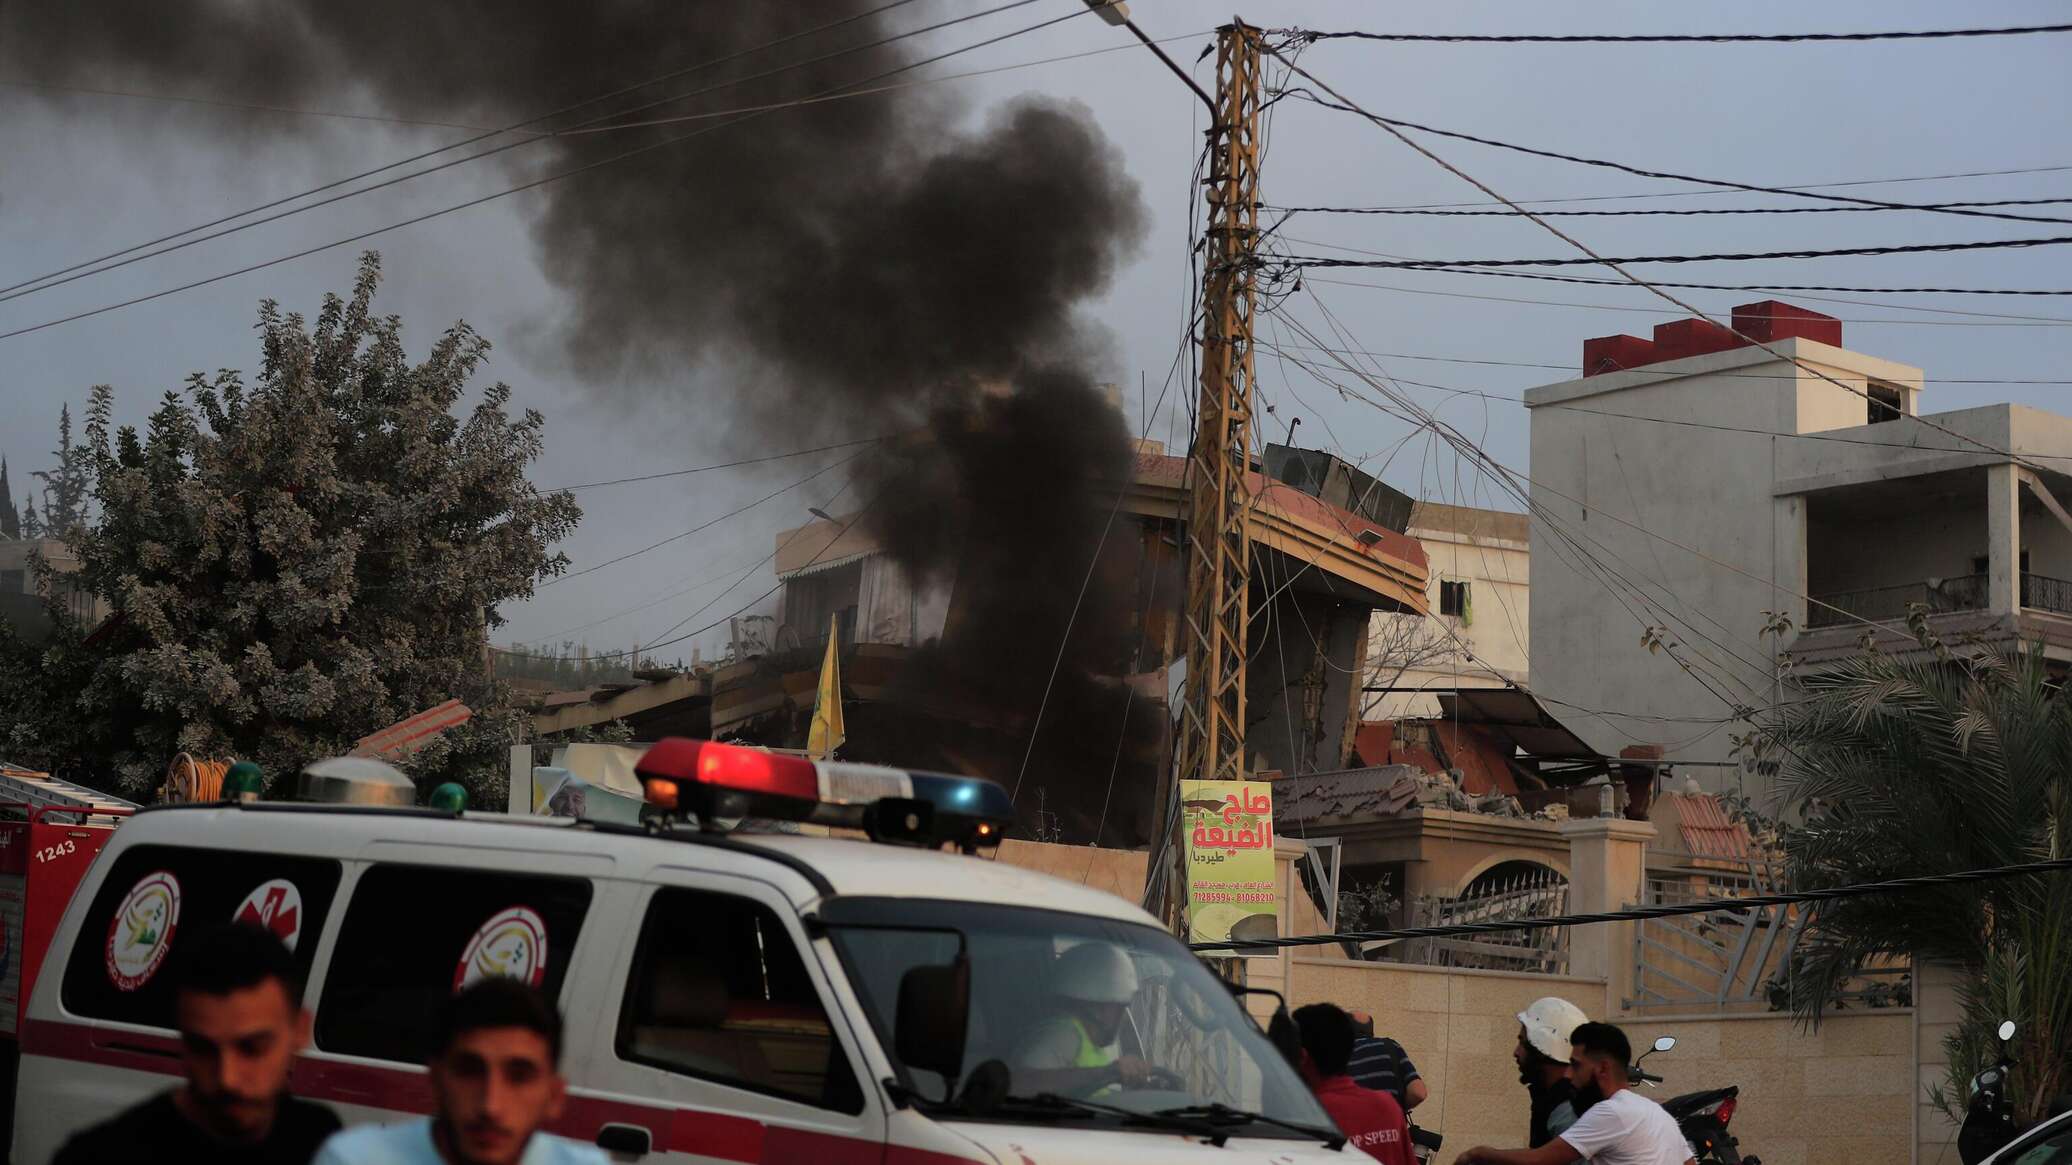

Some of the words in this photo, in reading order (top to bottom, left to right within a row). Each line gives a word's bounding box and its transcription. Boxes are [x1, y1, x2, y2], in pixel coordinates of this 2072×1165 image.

[1223, 786, 1270, 825] صاج
[1193, 819, 1272, 857] الضيعة
[36, 840, 76, 863] 1243
[1193, 851, 1225, 865] طيردبا
[1364, 1128, 1400, 1146] SPEED
